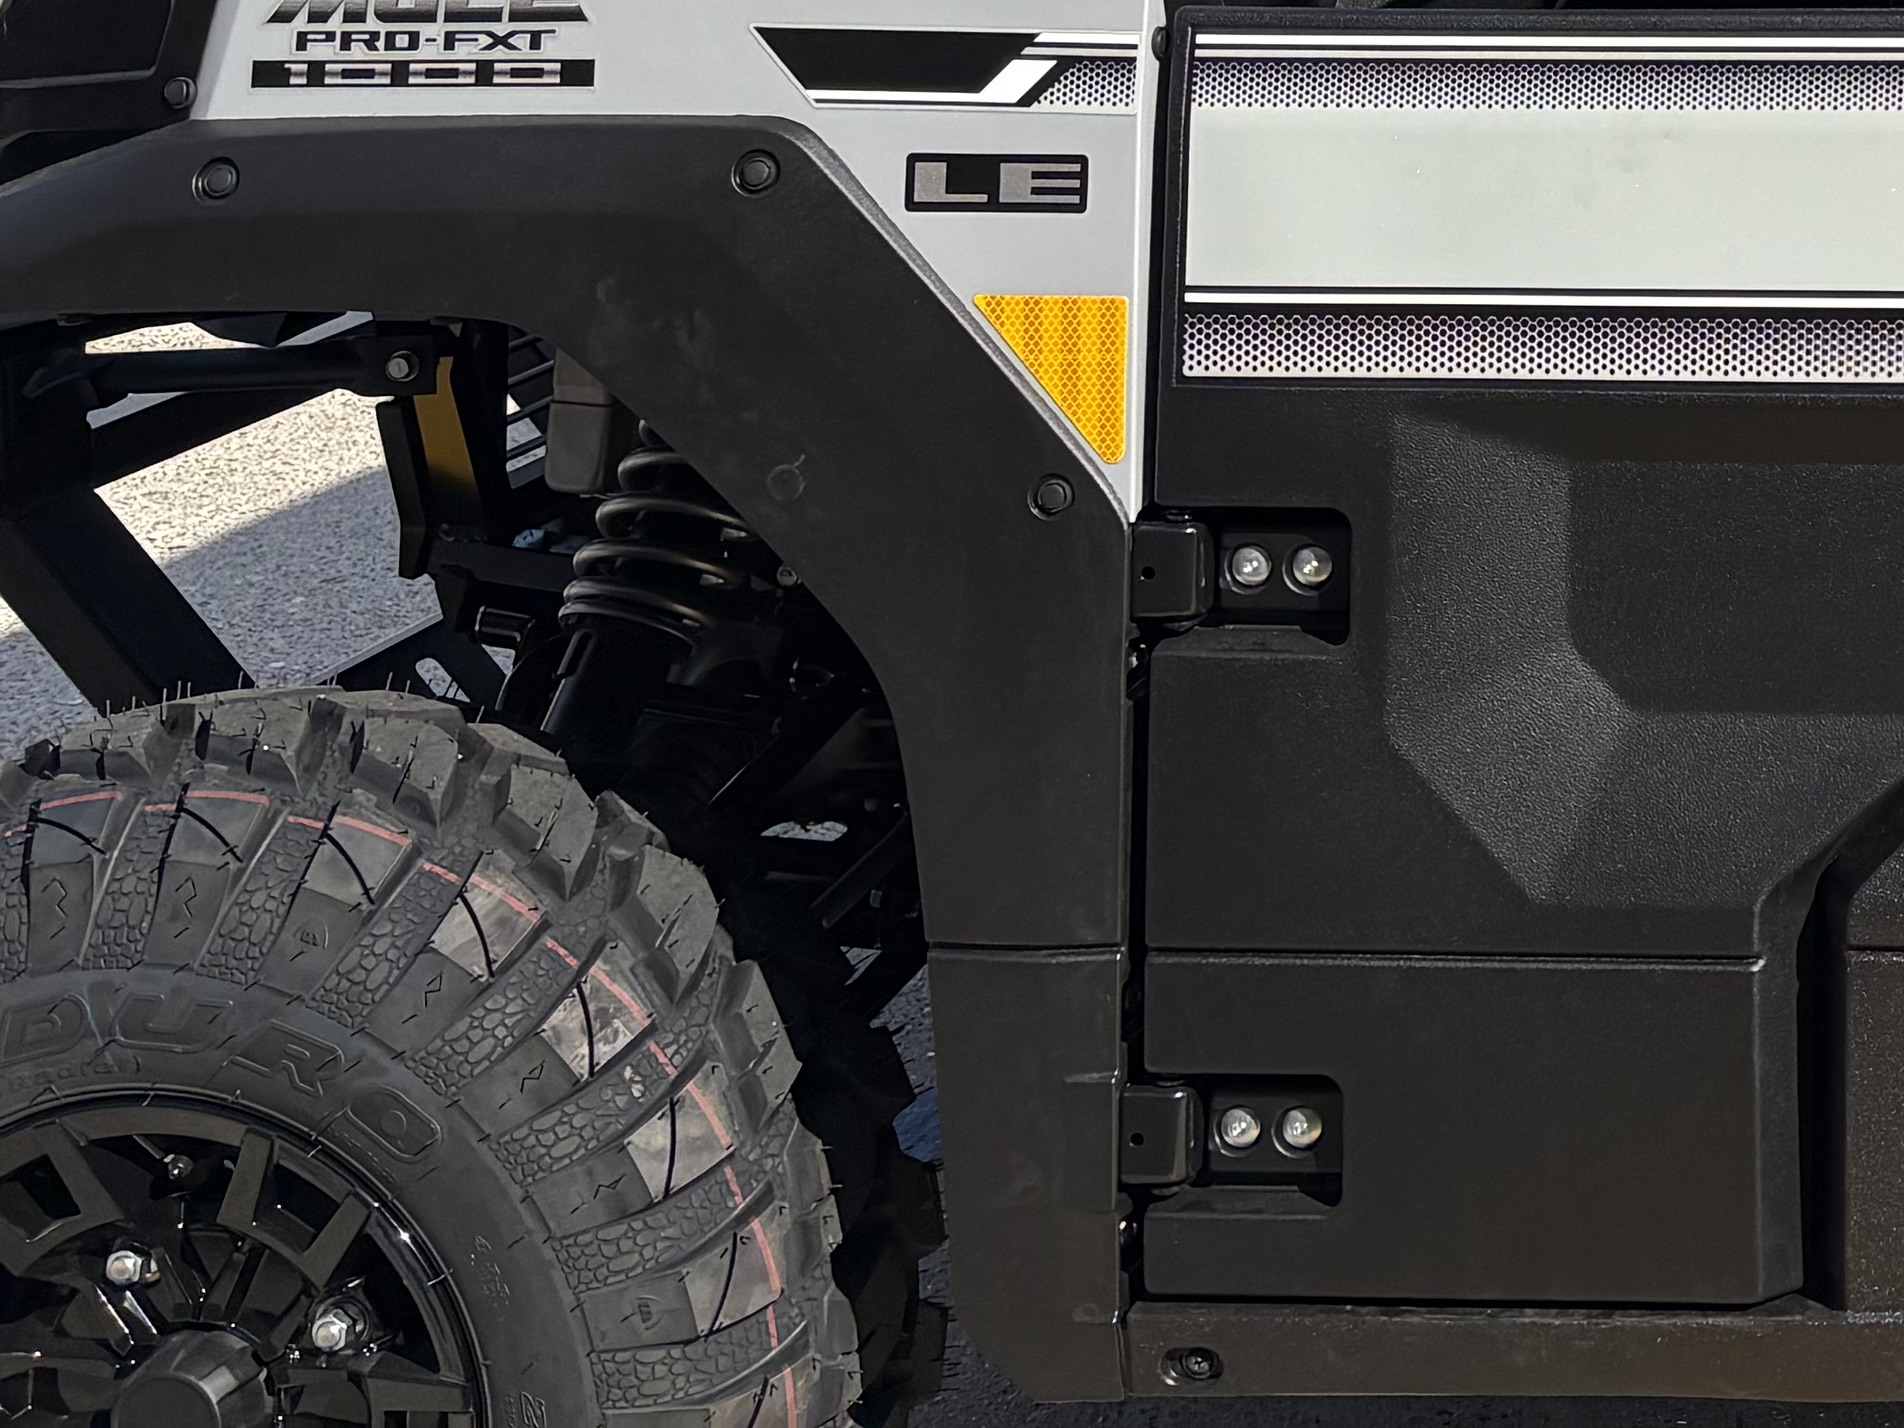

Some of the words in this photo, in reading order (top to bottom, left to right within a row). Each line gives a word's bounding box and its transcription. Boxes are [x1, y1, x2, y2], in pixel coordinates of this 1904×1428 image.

[295, 29, 557, 52] PRO-FXT
[284, 63, 561, 84] 1000
[912, 162, 1081, 202] LE
